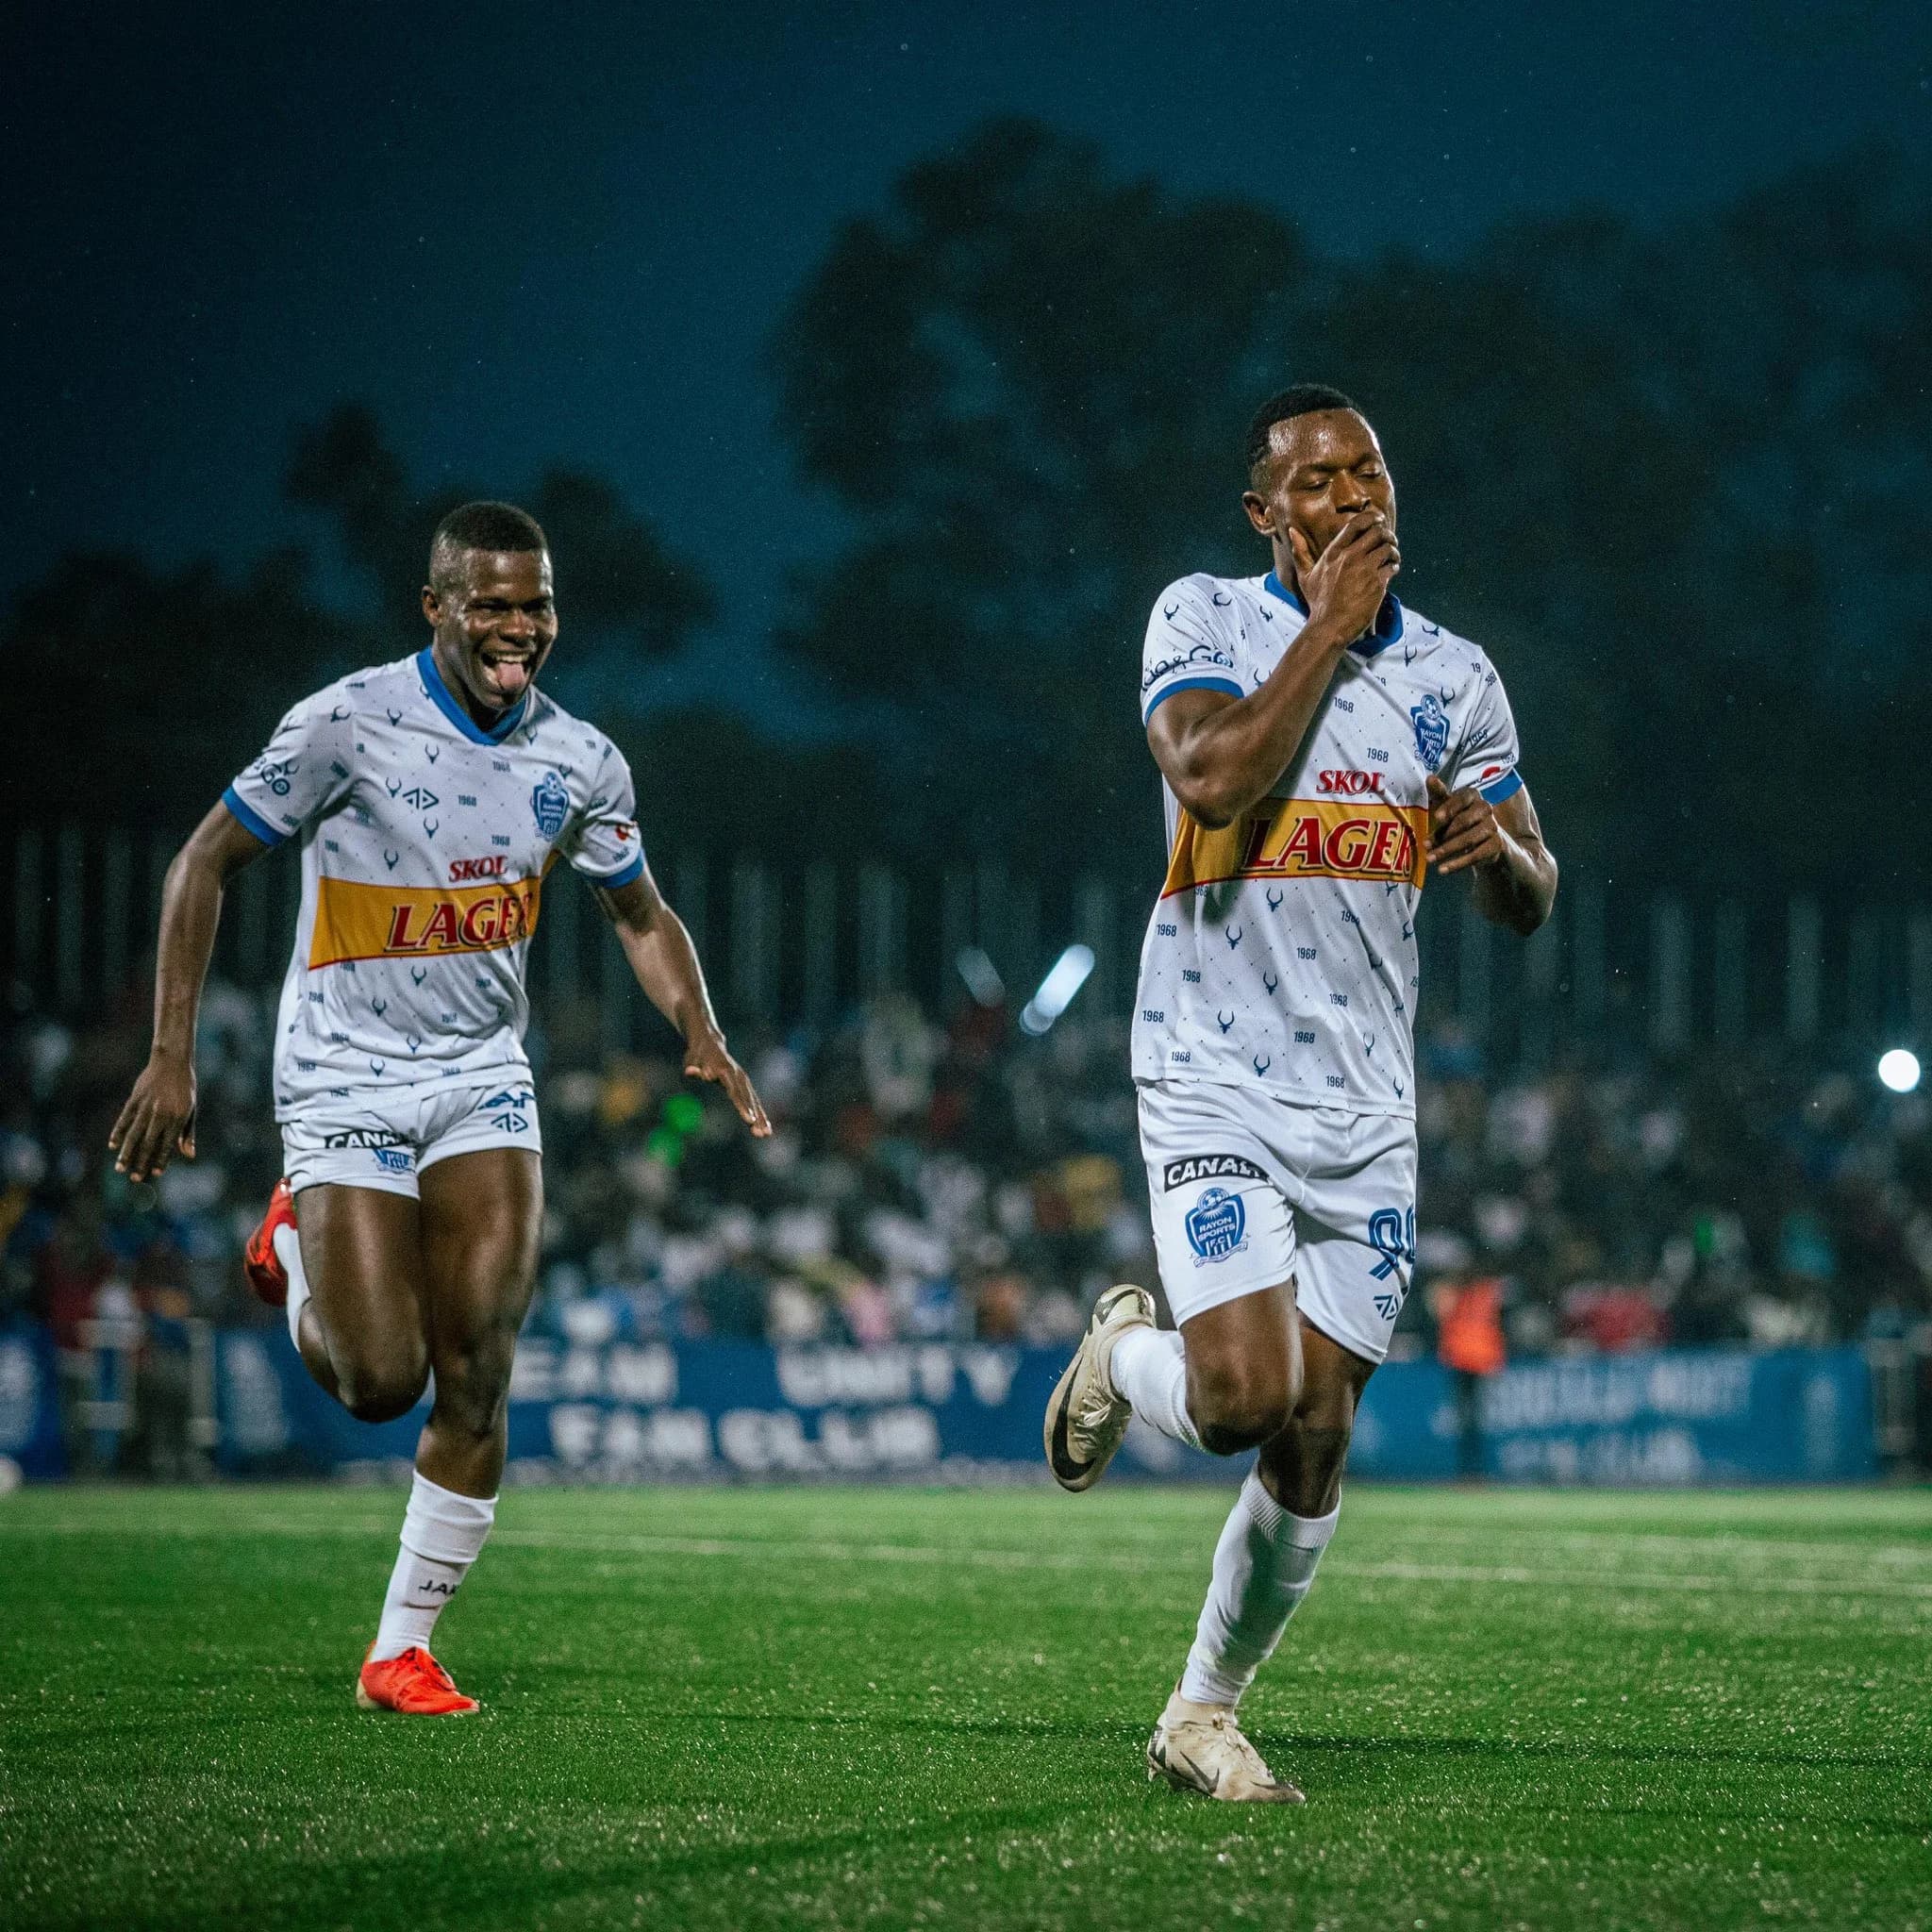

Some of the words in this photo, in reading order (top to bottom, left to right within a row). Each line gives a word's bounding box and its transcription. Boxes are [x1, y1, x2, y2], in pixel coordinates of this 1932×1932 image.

[1334, 696, 1354, 713] 1968
[1367, 747, 1389, 762] 1968
[448, 855, 508, 883] SKOL
[1157, 924, 1177, 937] 1968
[1296, 947, 1317, 960] 1968
[1182, 969, 1201, 983] 1968
[1329, 993, 1348, 1008] 1968
[1142, 1009, 1164, 1024] 1968
[1293, 1030, 1315, 1044] 1968
[1171, 1051, 1191, 1063] 1968
[1325, 1075, 1345, 1089] 1968
[1199, 1215, 1232, 1233] RAYON
[1198, 1223, 1236, 1242] SPORTS
